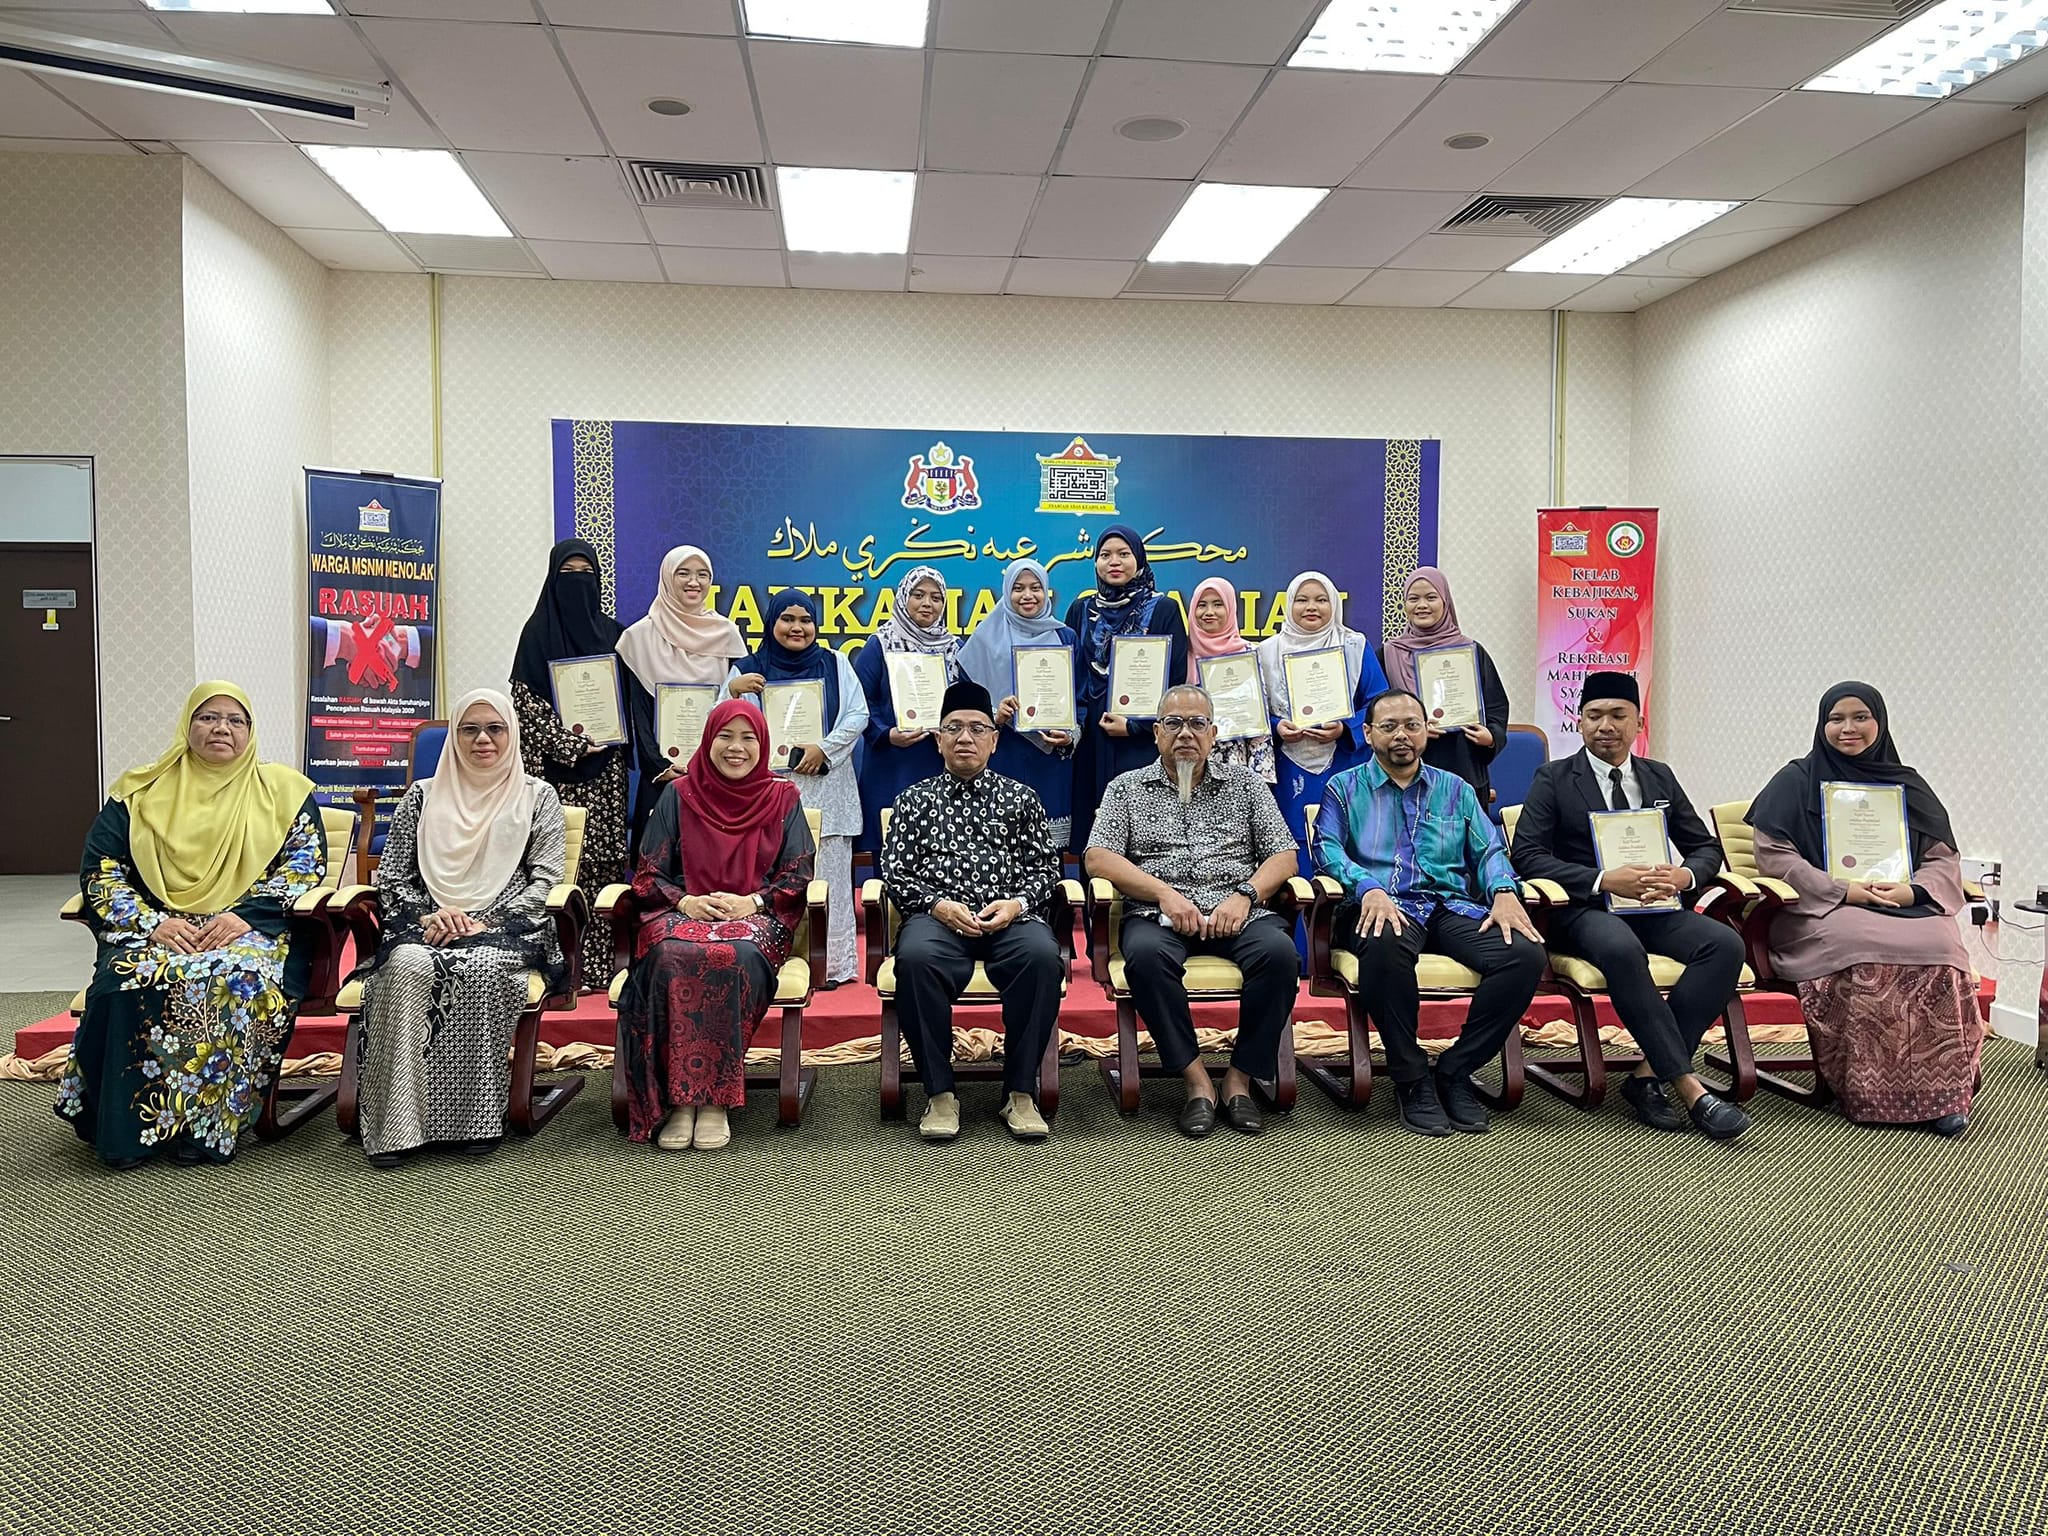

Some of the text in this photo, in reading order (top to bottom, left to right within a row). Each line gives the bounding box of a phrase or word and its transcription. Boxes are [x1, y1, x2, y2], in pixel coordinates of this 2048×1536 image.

[311, 553, 434, 581] WARGA MSNM MENOLAK
[1572, 568, 1620, 581] KELAB
[1553, 586, 1639, 599] KEBAJIKAN,
[319, 587, 428, 620] RASUAH
[1568, 607, 1618, 619] SUKAN
[1585, 627, 1603, 643] &
[1558, 652, 1629, 665] REKREASI
[310, 758, 336, 767] Laporkan
